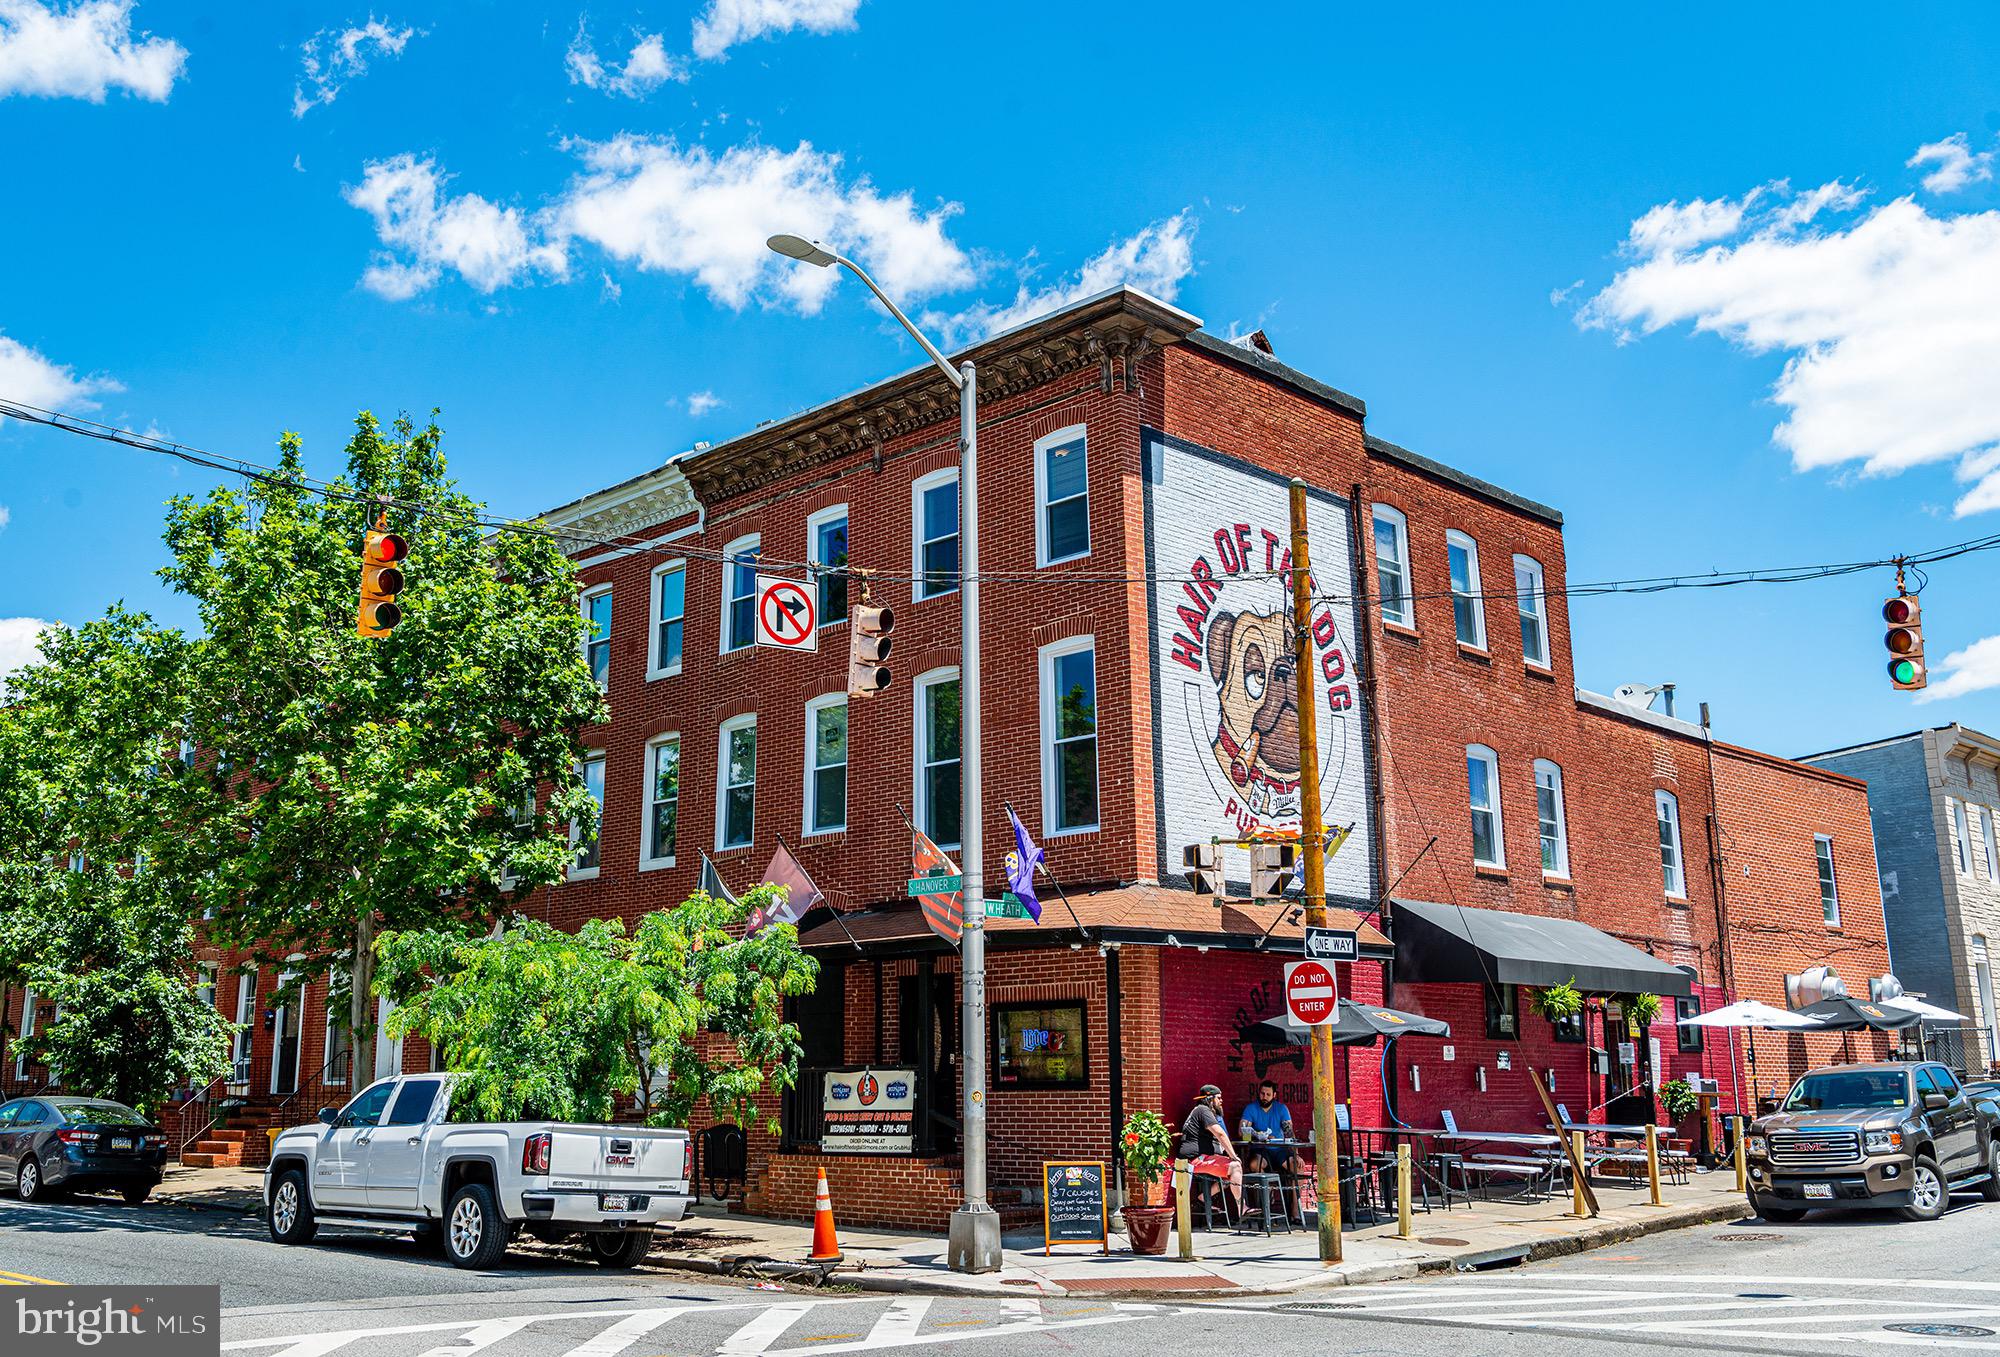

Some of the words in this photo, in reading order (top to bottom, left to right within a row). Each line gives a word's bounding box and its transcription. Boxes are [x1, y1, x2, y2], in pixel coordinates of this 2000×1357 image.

[1171, 556, 1223, 672] HAIR
[1214, 524, 1252, 577] OF
[1260, 528, 1316, 594] TH
[1312, 610, 1351, 712] DOG
[916, 879, 949, 892] HANOVER
[1315, 938, 1329, 951] ONE
[1333, 938, 1352, 951] WAY
[1294, 975, 1306, 985] DO
[1310, 973, 1326, 984] NOT
[1299, 1001, 1325, 1012] ENTER
[1282, 1082, 1309, 1104] GRUB
[859, 1124, 878, 1133] SUNDAY
[1794, 1142, 1829, 1151] GMC
[606, 1156, 635, 1165] GMC
